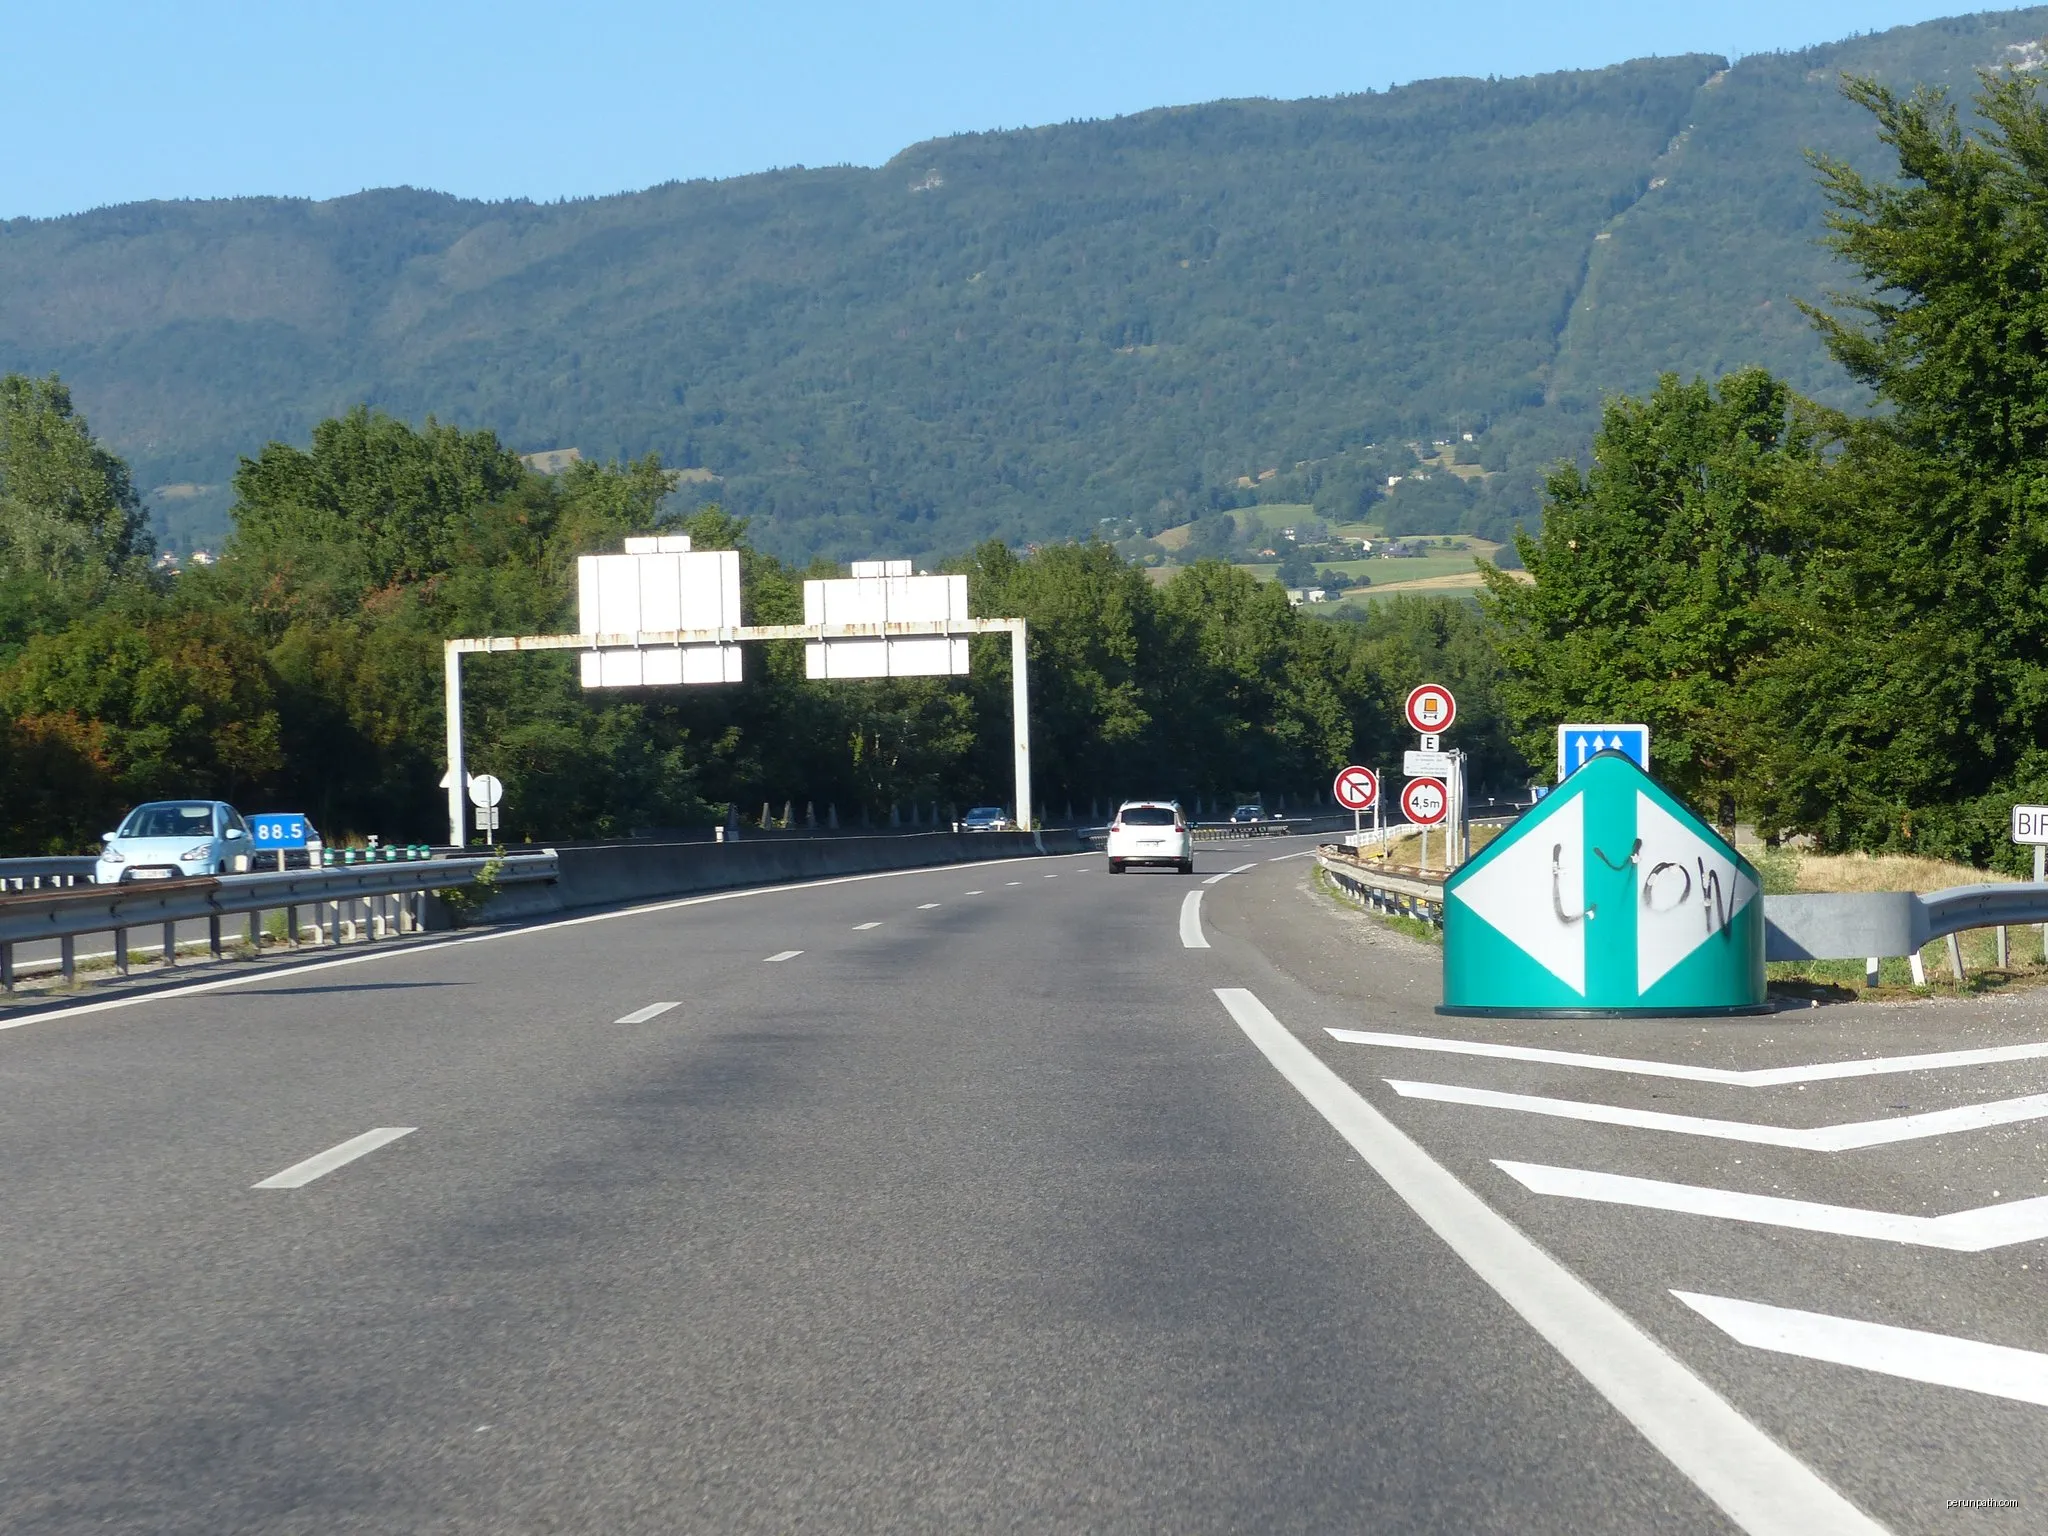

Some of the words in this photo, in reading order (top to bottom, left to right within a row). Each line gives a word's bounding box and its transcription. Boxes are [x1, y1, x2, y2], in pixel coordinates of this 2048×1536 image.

[1426, 737, 1434, 750] E
[1411, 796, 1440, 809] 4,5m
[258, 823, 303, 840] 88.5
